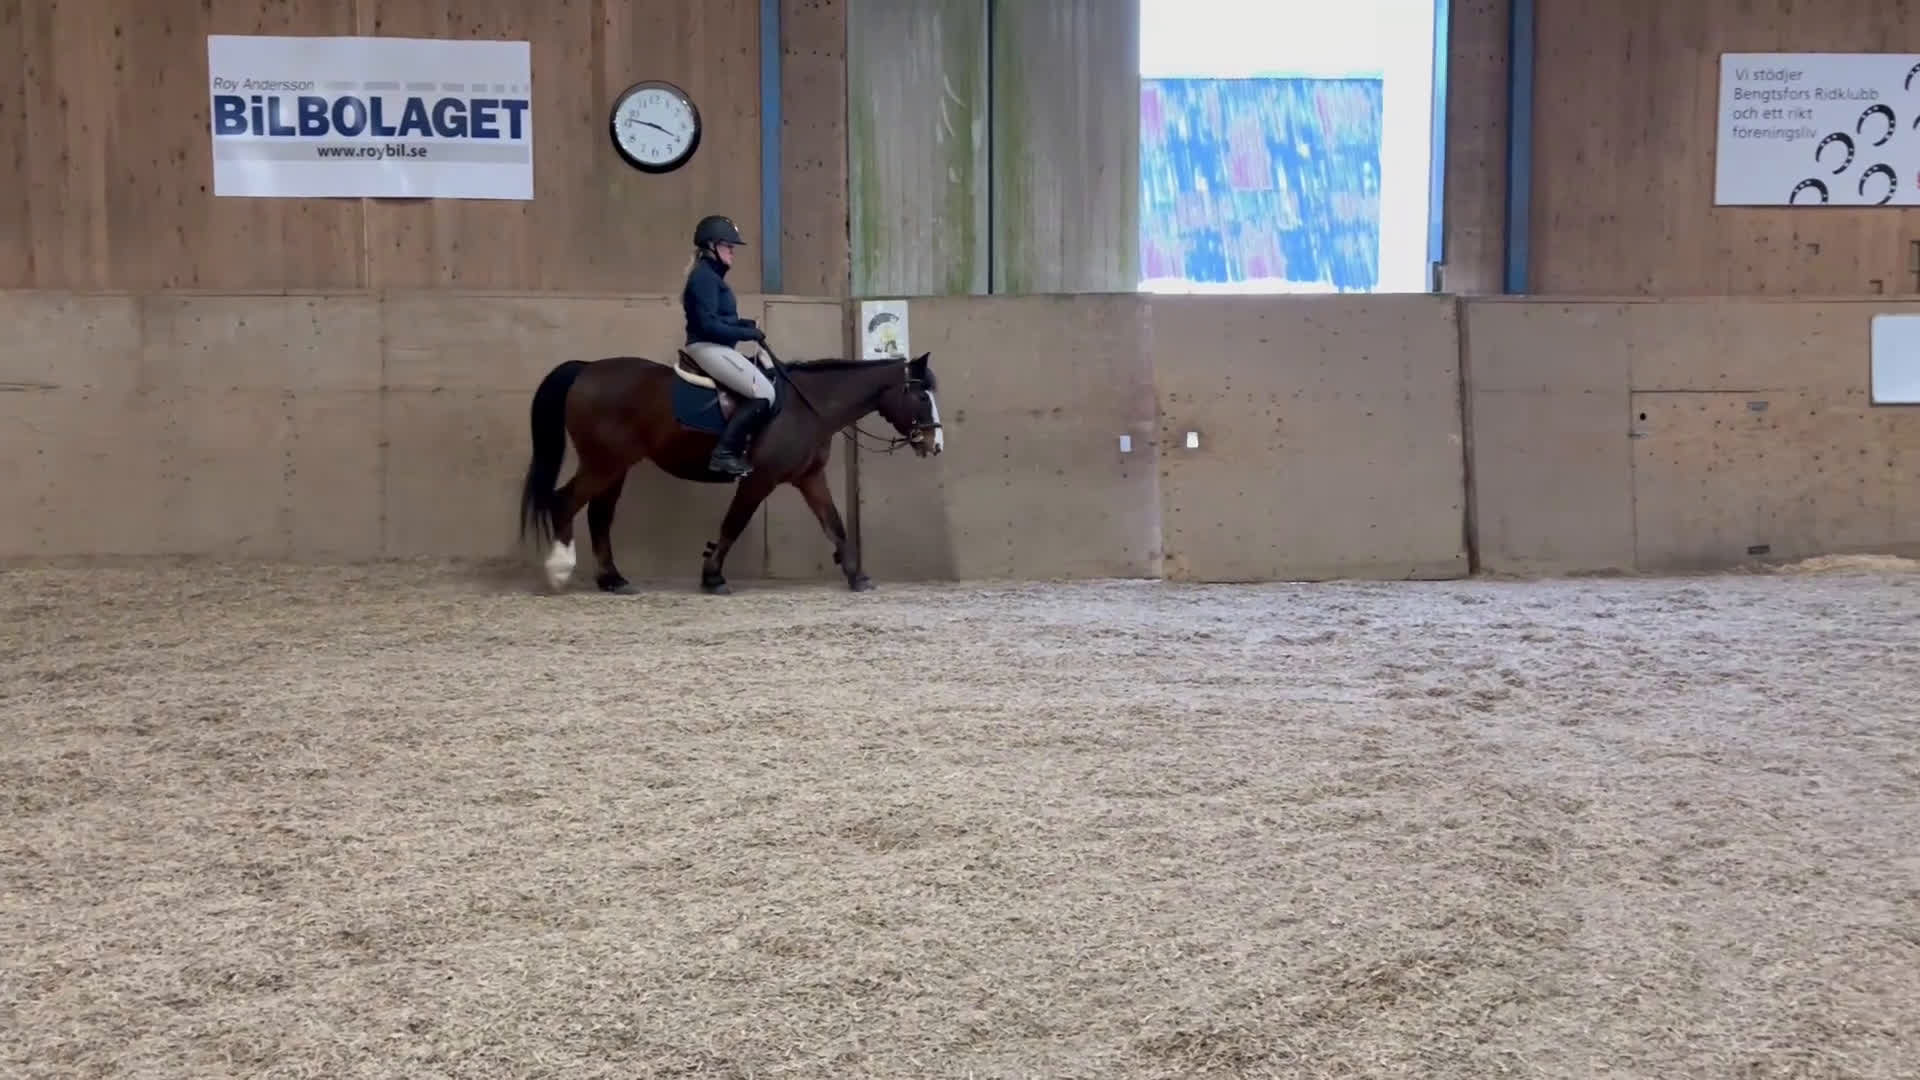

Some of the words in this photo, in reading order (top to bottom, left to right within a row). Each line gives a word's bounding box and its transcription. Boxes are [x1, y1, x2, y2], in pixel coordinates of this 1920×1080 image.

[1735, 68, 1749, 81] Vi
[1753, 68, 1803, 84] stödjer
[213, 77, 239, 92] Roy
[243, 78, 315, 92] Andersson
[1734, 87, 1810, 103] Bengtsfors
[1815, 87, 1880, 101] Ridklubb
[213, 95, 529, 139] BiLBOLAGET
[1733, 107, 1758, 120] och
[1762, 107, 1784, 120] ett
[1788, 107, 1814, 120] rikt
[1733, 126, 1817, 142] föreningsliv
[317, 144, 428, 161] www.roybil.se
